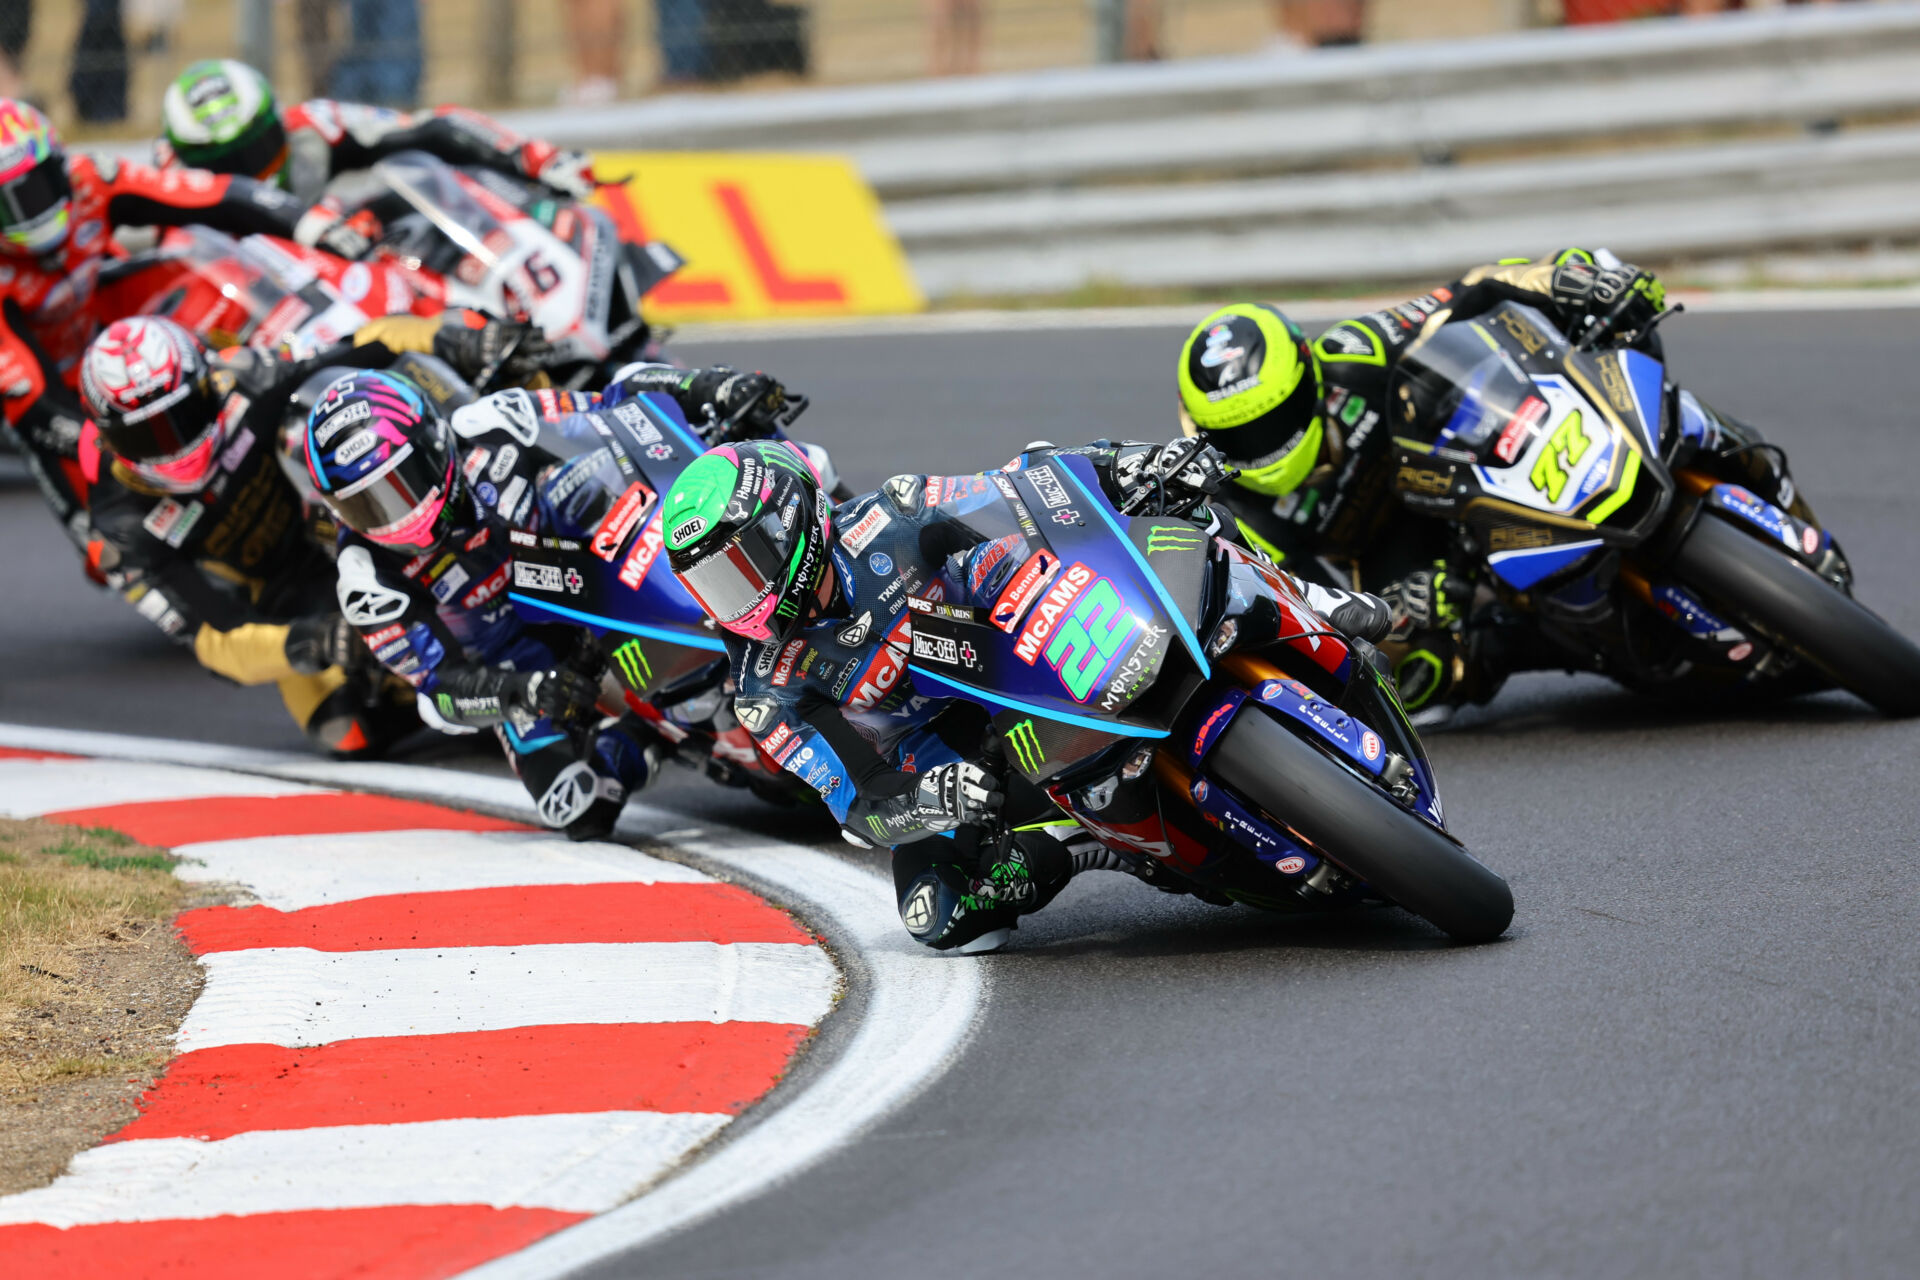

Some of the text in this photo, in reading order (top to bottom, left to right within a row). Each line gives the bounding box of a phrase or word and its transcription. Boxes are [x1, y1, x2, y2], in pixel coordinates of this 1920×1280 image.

[524, 250, 562, 300] 6
[1206, 374, 1262, 402] SHARK
[1529, 408, 1591, 504] 77
[736, 457, 756, 500] Hanworth
[1027, 467, 1070, 507] Muc-Off
[783, 506, 793, 528] SHOEI
[818, 493, 826, 521] SHOEI
[849, 509, 881, 540] YAMAHA
[673, 519, 702, 543] SHOEI
[792, 526, 819, 595] MONSTER
[738, 580, 775, 618] DISTINCTION
[907, 596, 932, 612] WRS
[936, 604, 970, 618] EDWARDS
[1016, 566, 1090, 661] McAMS
[915, 635, 956, 661] Muc-Off
[1044, 577, 1137, 702] 22
[774, 639, 804, 685] McAMS
[1101, 625, 1167, 710] MONSTER
[1126, 649, 1162, 700] ENERGY
[1298, 704, 1349, 743] PIRELLI
[1224, 811, 1277, 847] PIRELLI
